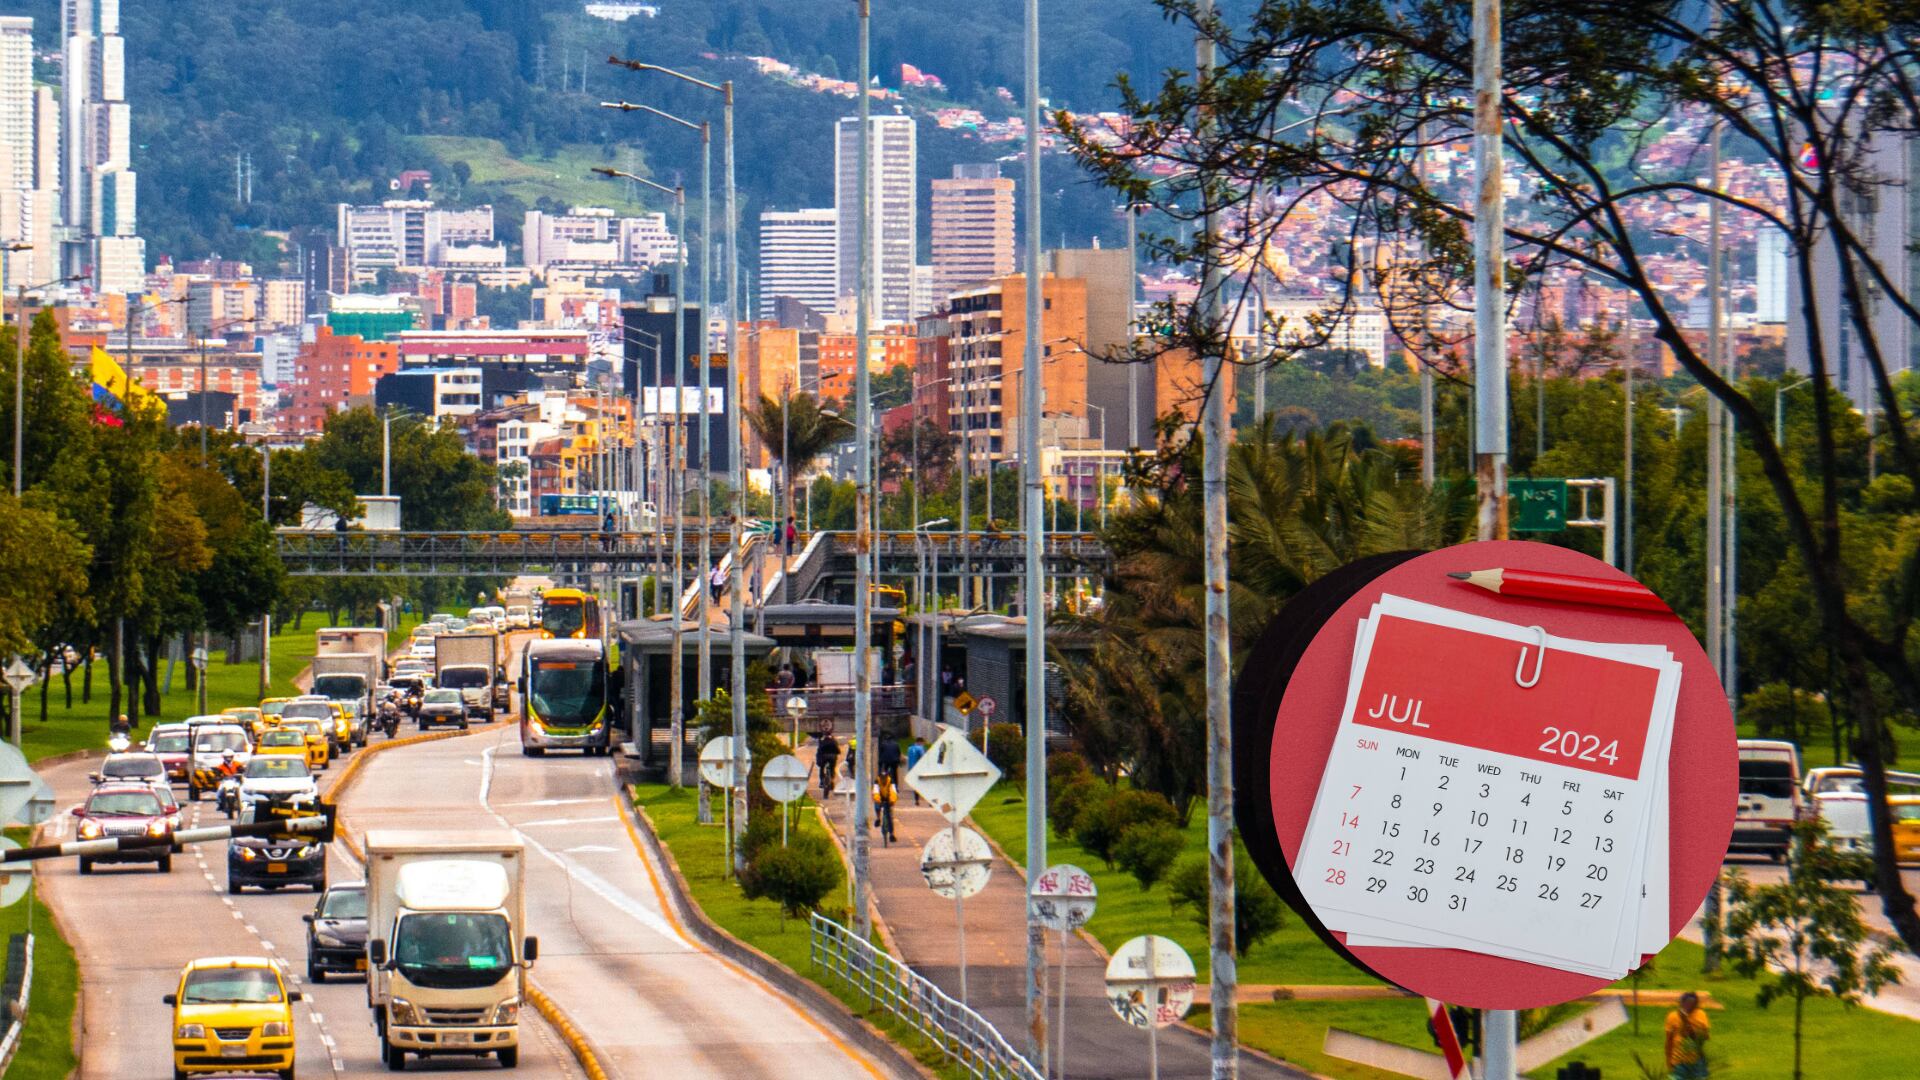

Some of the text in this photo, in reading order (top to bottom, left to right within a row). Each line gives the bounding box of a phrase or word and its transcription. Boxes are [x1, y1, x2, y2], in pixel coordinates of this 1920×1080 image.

[1369, 693, 1619, 765] JUL 2024
[1357, 739, 1625, 800] SUN MON TUE WED THU FRI SAT
[1401, 767, 1613, 823] 1 2 3 4 5 6
[1342, 813, 1607, 881] 14 15 16 17 18 19 20
[1351, 786, 1613, 853] 7 8 9 10 11 12 13
[1325, 868, 1467, 911] 28 29 30 31
[1332, 840, 1602, 909] 21 22 23 24 25 26 27
